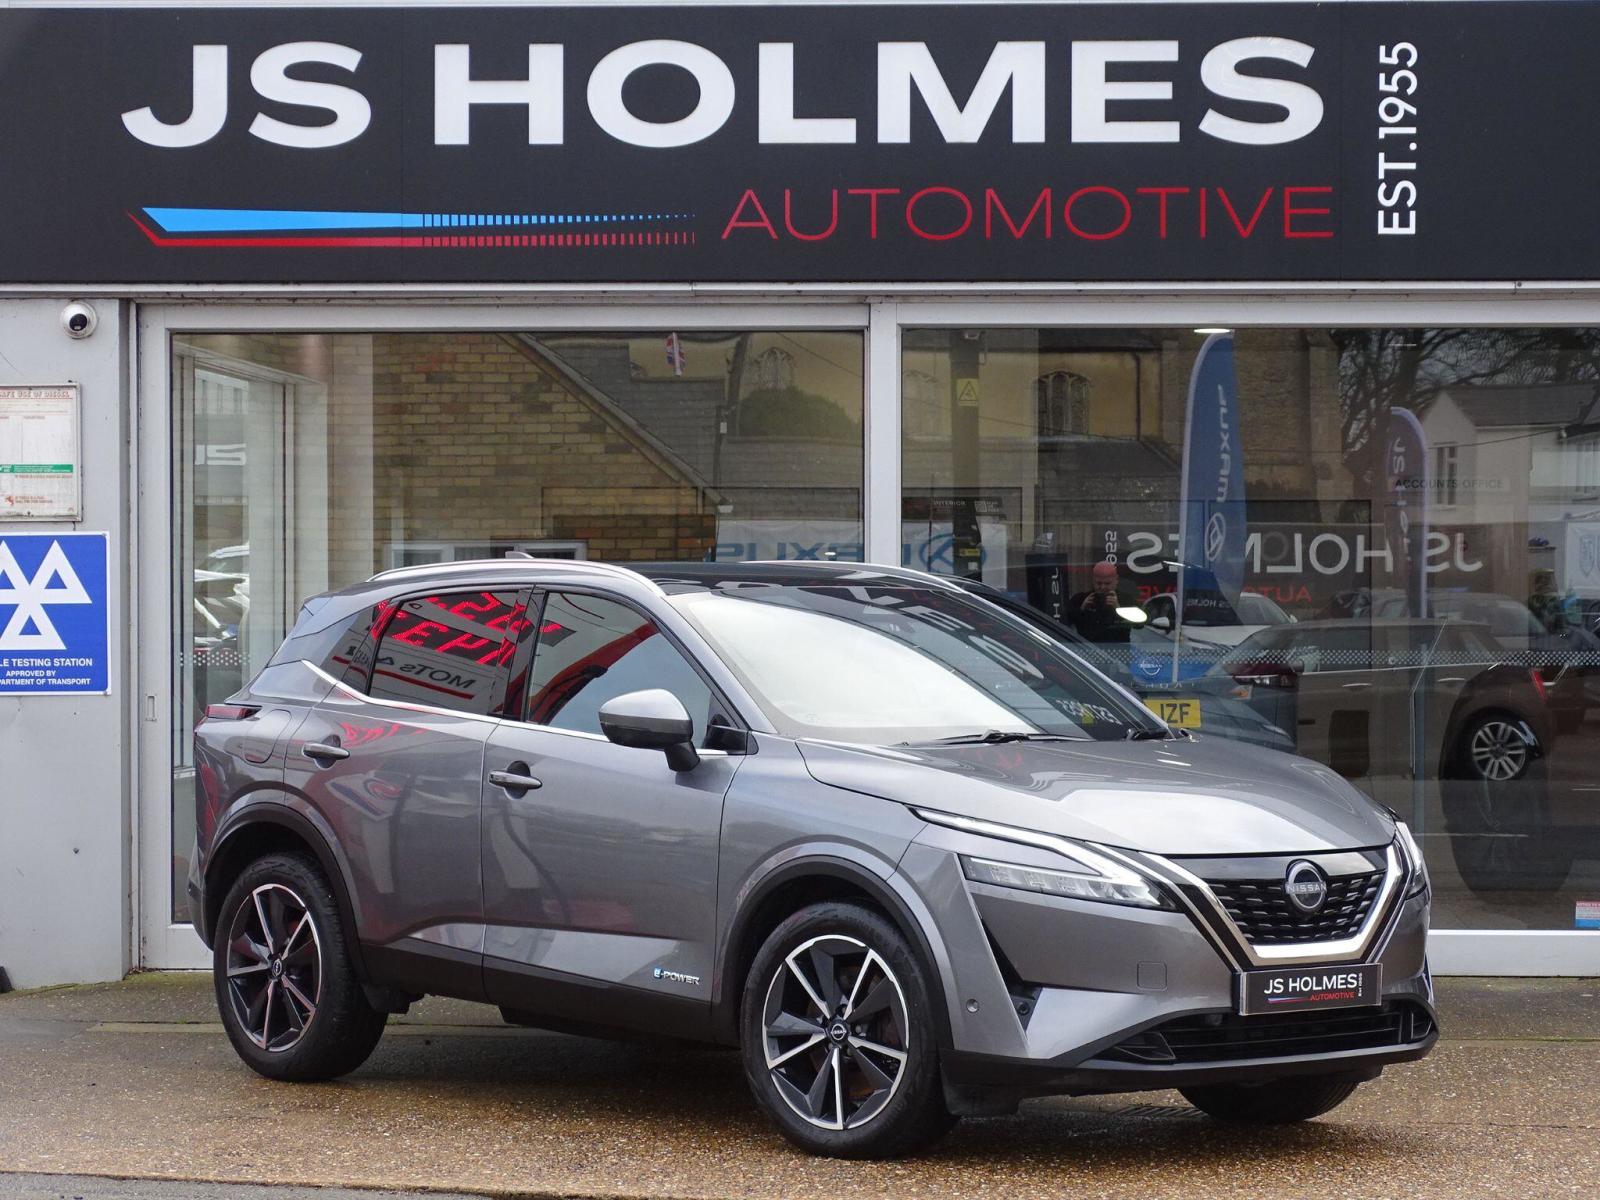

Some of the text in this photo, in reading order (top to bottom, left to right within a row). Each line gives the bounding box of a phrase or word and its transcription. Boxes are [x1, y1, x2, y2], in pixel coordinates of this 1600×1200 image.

[121, 35, 1324, 149] JS HOLMES
[1377, 41, 1418, 237] EST.1955
[721, 185, 1335, 242] AUTOMOTIVE
[11, 658, 51, 667] TESTING
[53, 658, 93, 667] STATION
[1286, 881, 1327, 893] NISSAN
[1264, 978, 1284, 995] JS
[1288, 973, 1358, 993] HOLMES
[1310, 991, 1355, 1001] AUTOMOTIVE
